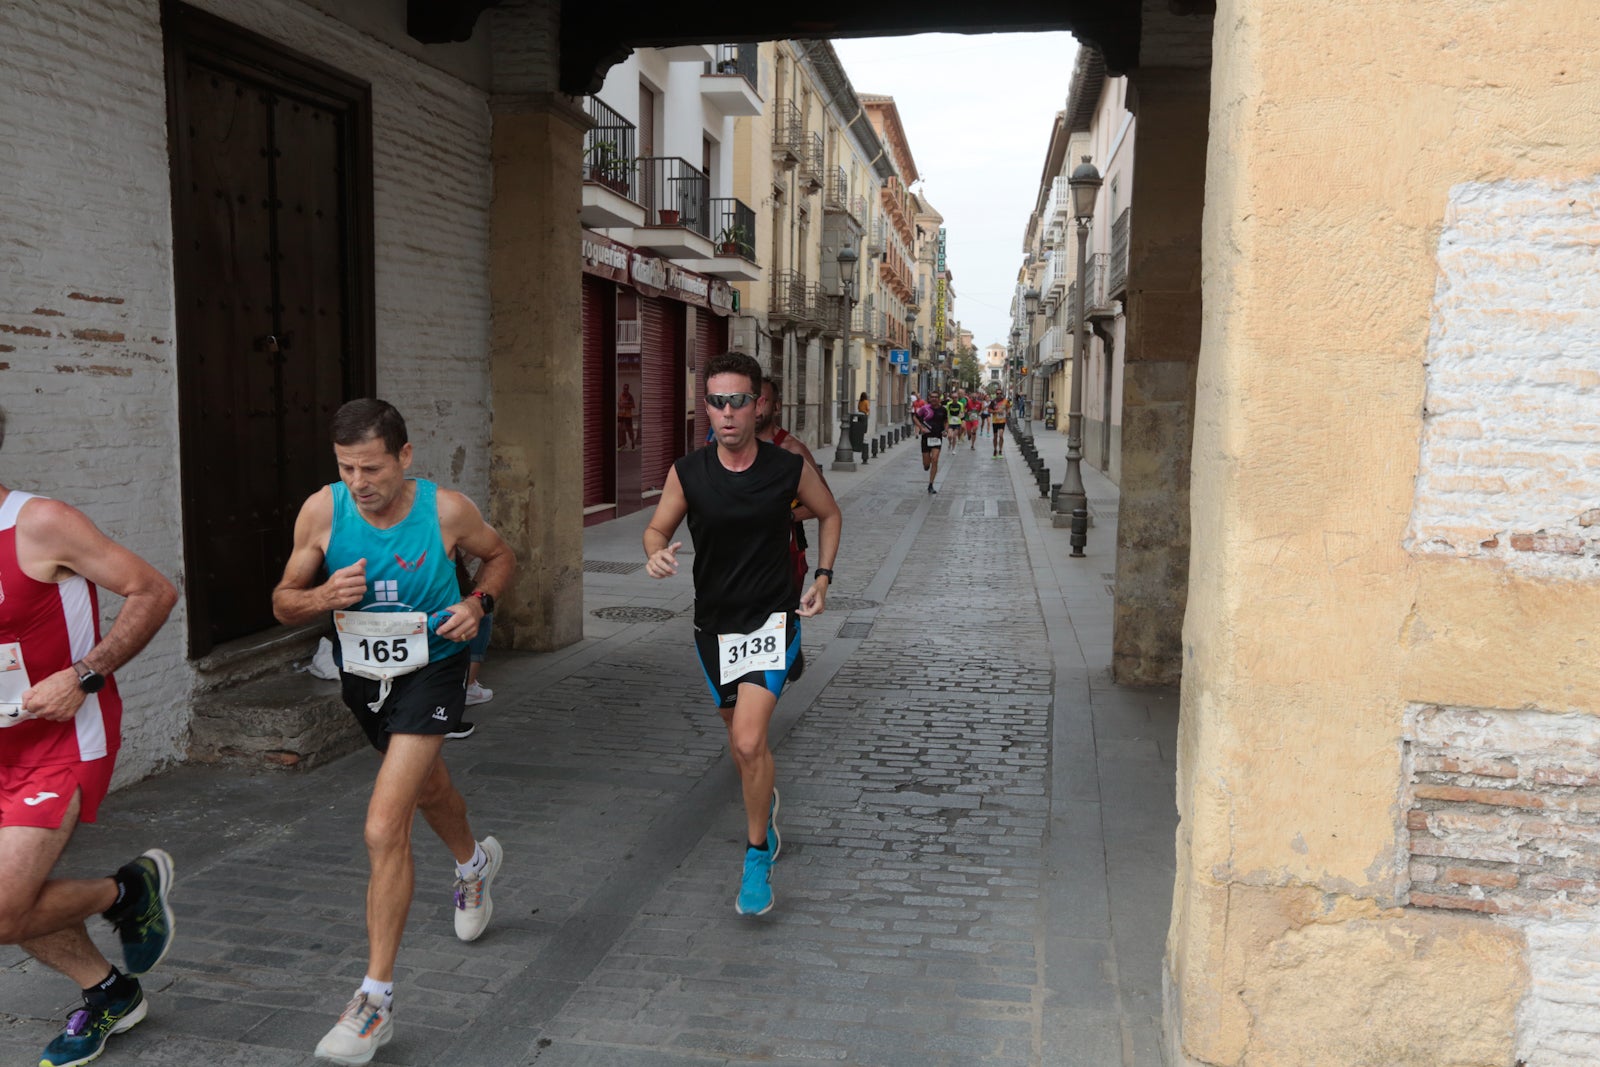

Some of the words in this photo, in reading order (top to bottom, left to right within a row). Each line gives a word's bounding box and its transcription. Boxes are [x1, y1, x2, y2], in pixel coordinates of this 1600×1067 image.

[582, 239, 627, 270] roguerías
[359, 638, 409, 663] 165
[728, 636, 776, 664] 3138
